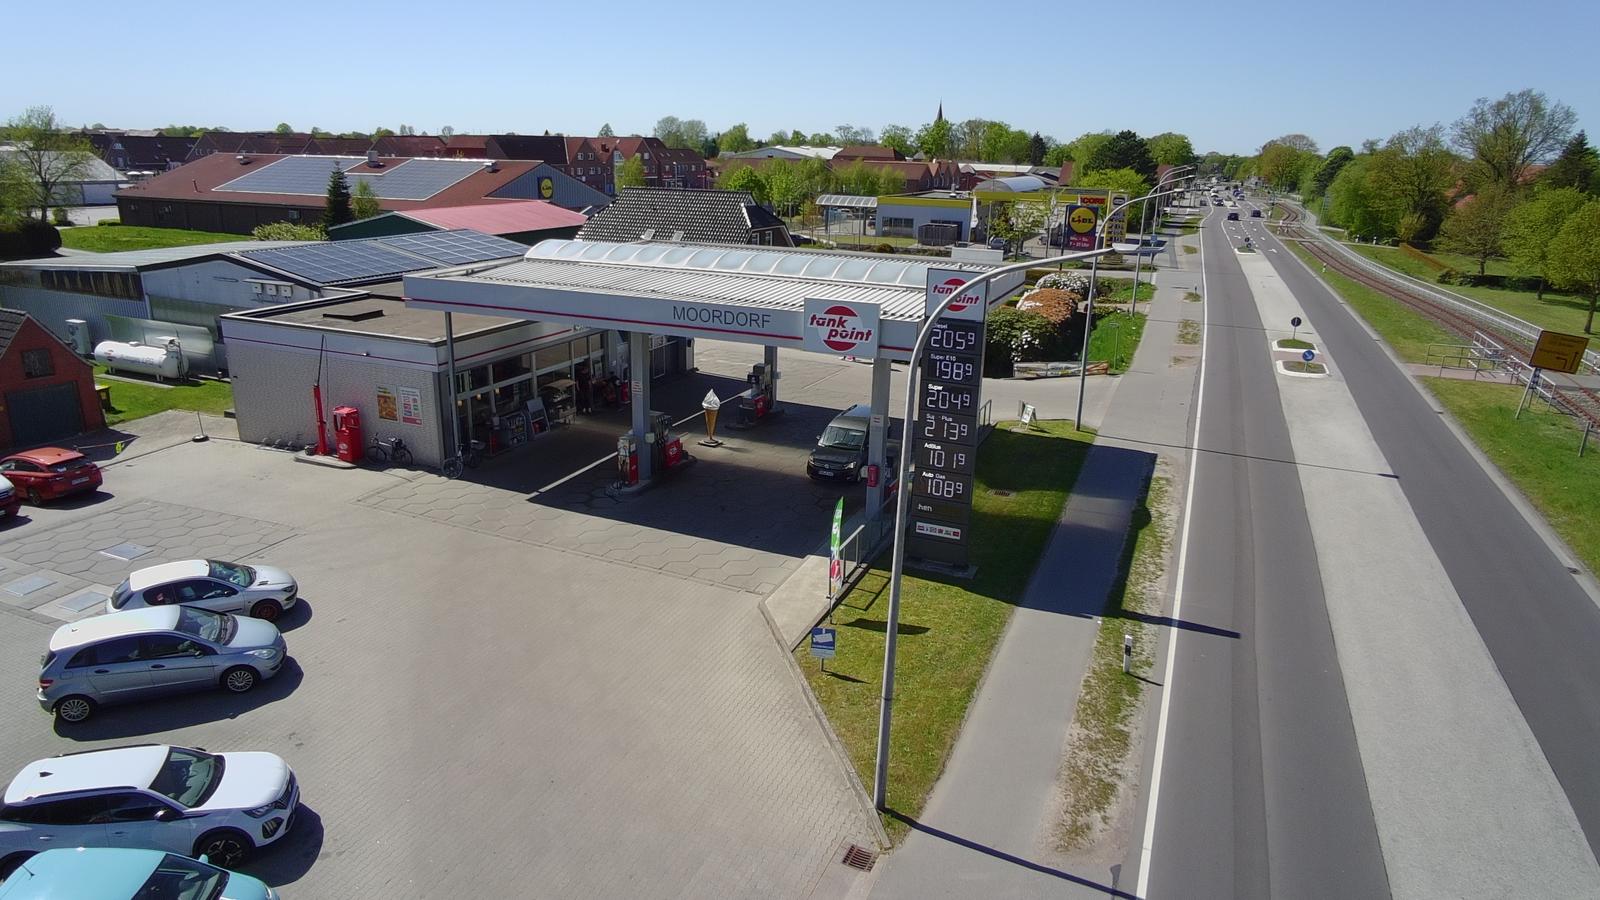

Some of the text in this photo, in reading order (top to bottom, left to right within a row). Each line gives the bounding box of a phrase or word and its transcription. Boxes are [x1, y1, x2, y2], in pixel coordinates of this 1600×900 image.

[932, 284, 956, 296] tan
[672, 305, 772, 329] MOORDORF
[809, 313, 848, 329] tank
[827, 326, 873, 342] point
[930, 329, 975, 350] 2059
[936, 361, 973, 380] 1989
[927, 383, 943, 391] Super
[926, 390, 970, 410] 2049
[927, 478, 963, 498] 1089
